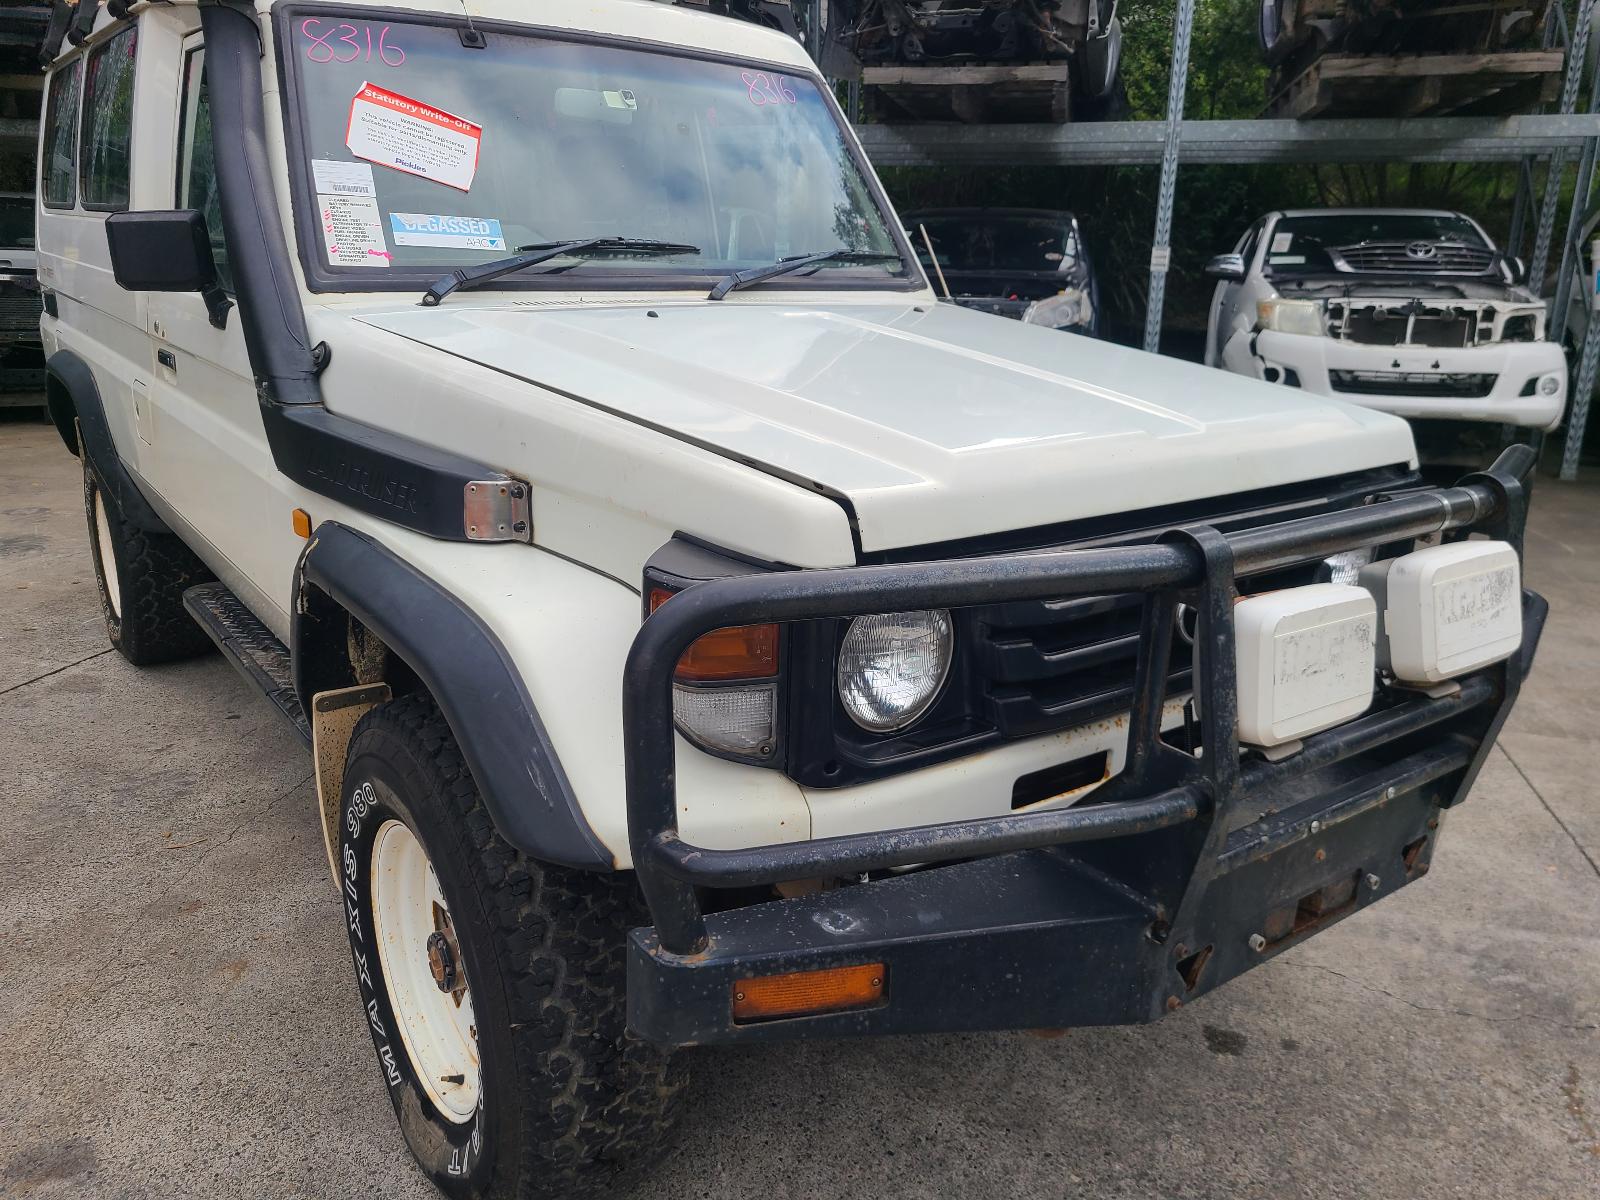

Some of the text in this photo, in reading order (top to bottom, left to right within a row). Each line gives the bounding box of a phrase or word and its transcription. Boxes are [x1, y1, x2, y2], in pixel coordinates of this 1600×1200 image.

[301, 19, 406, 67] 8316
[364, 88, 471, 131] Statutory Write-Off
[741, 72, 796, 105] 8316
[394, 157, 427, 173] Pickles
[344, 781, 402, 1087] MAXXIS 980
